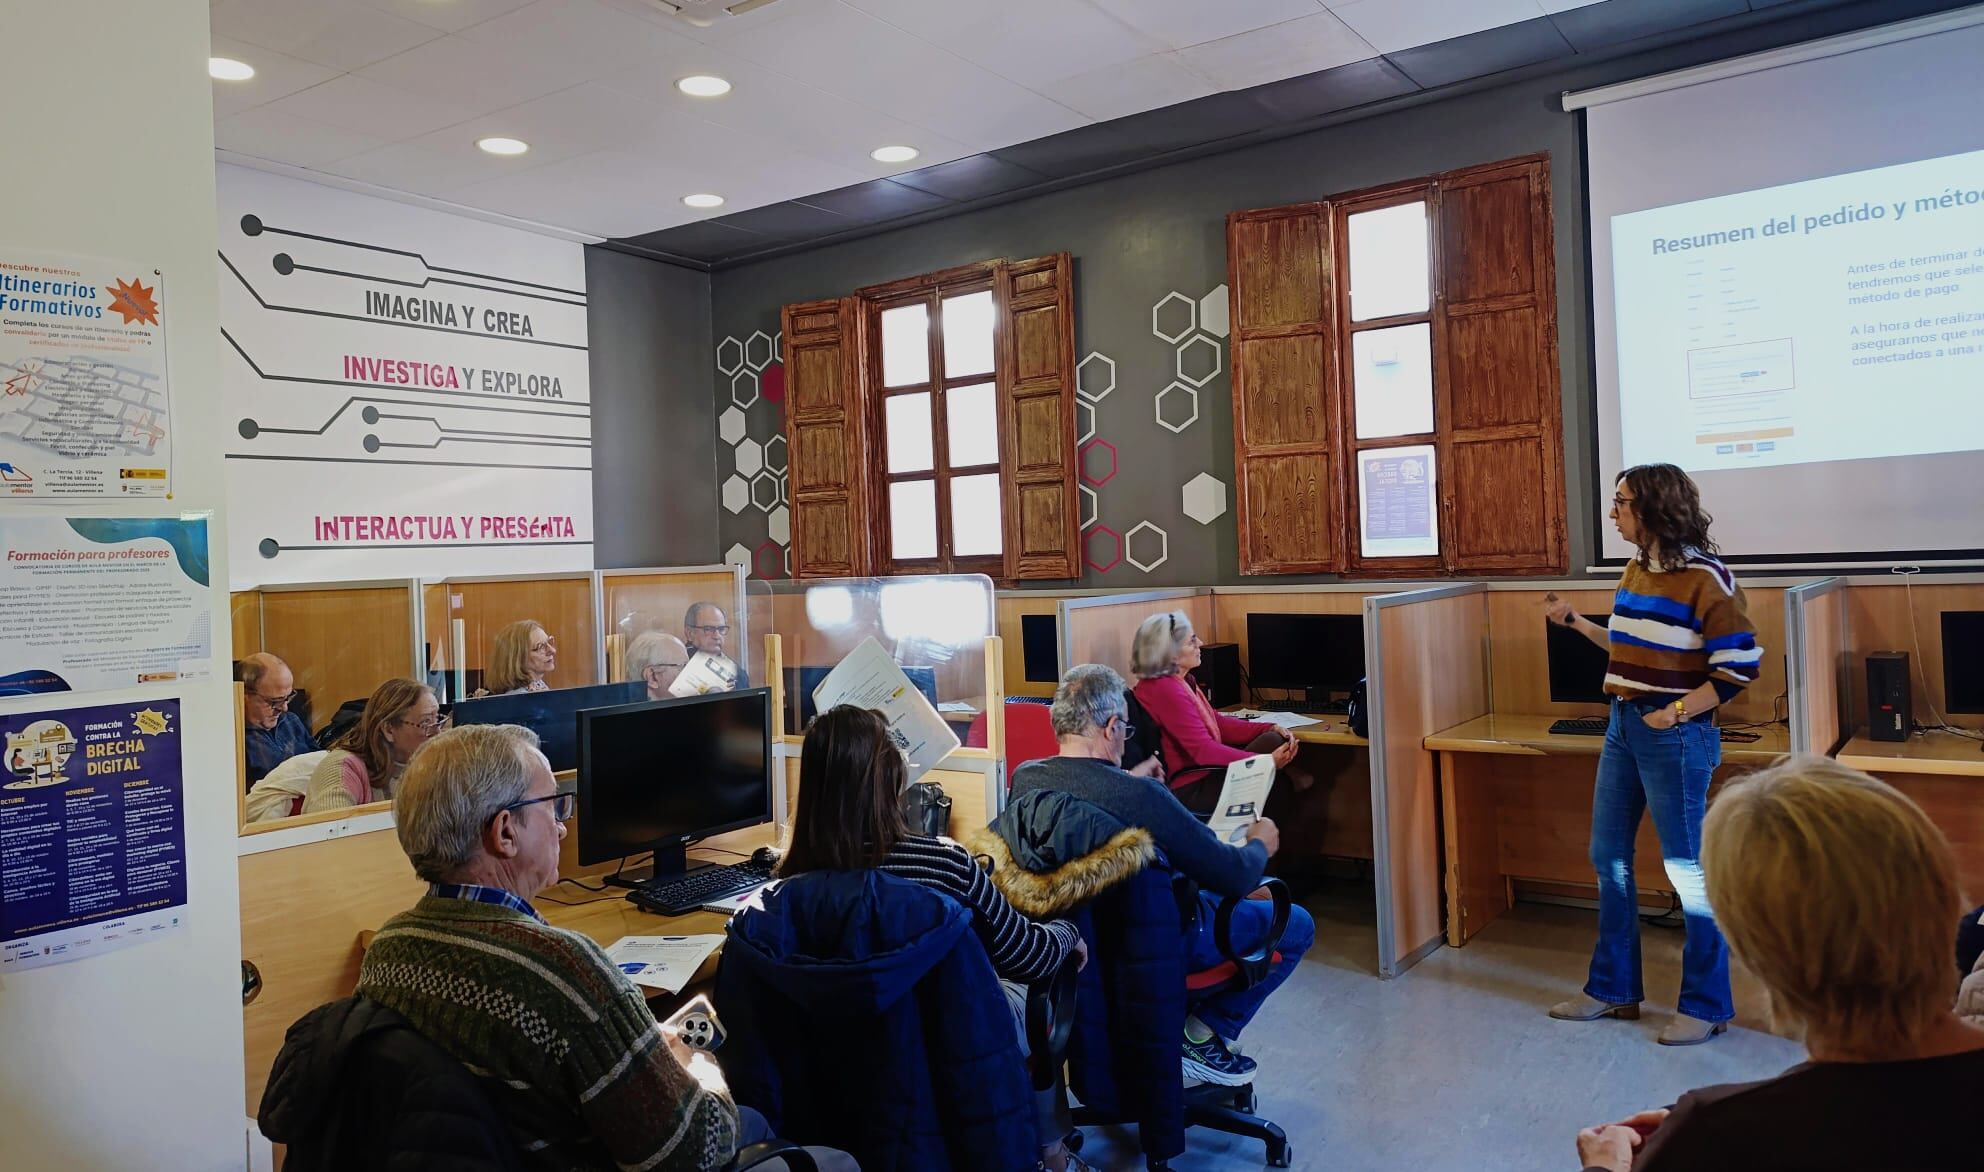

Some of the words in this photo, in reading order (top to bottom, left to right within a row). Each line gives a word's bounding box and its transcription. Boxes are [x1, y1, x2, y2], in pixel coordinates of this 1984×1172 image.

[1652, 225, 1755, 255] Resumen
[1762, 215, 1796, 237] del
[1803, 202, 1885, 234] pedido
[1893, 201, 1906, 220] y
[42, 266, 81, 277] nuestros
[1847, 262, 1885, 274] Antes
[1889, 258, 1906, 269] de
[1910, 250, 1968, 266] terminar
[1848, 273, 1921, 290] tendremos
[1925, 269, 1951, 282] que
[1904, 288, 1921, 298] de
[1924, 284, 1959, 298] pago
[0, 294, 103, 319] Formativos
[365, 290, 458, 327] IMAGINA
[461, 305, 475, 329] Y
[483, 309, 534, 337] CREA
[3, 318, 38, 327] Completa
[1850, 325, 1859, 335] A
[1863, 324, 1875, 334] la
[1879, 321, 1910, 332] hora
[1914, 317, 1931, 328] de
[1851, 332, 1937, 351] asegurarnos
[1941, 329, 1968, 342] que
[1852, 348, 1932, 366] conectados
[1936, 347, 1944, 357] a
[1948, 344, 1974, 356] una
[343, 355, 460, 389] INVESTIGA
[461, 367, 475, 390] Y
[481, 369, 564, 399] EXPLORA
[315, 515, 458, 541] INTERACTUA
[457, 516, 474, 540] Y
[7, 548, 75, 562] Formación
[77, 550, 106, 562] para
[108, 547, 170, 561] profesores
[85, 720, 123, 732] FORMACIÓN
[85, 732, 112, 742] CONTRA
[112, 731, 121, 739] LA
[86, 738, 145, 759] BRECHA
[87, 757, 141, 776] DIGITAL
[0, 797, 25, 805] OCTUBRE
[65, 787, 95, 796] NOVIEMBRE
